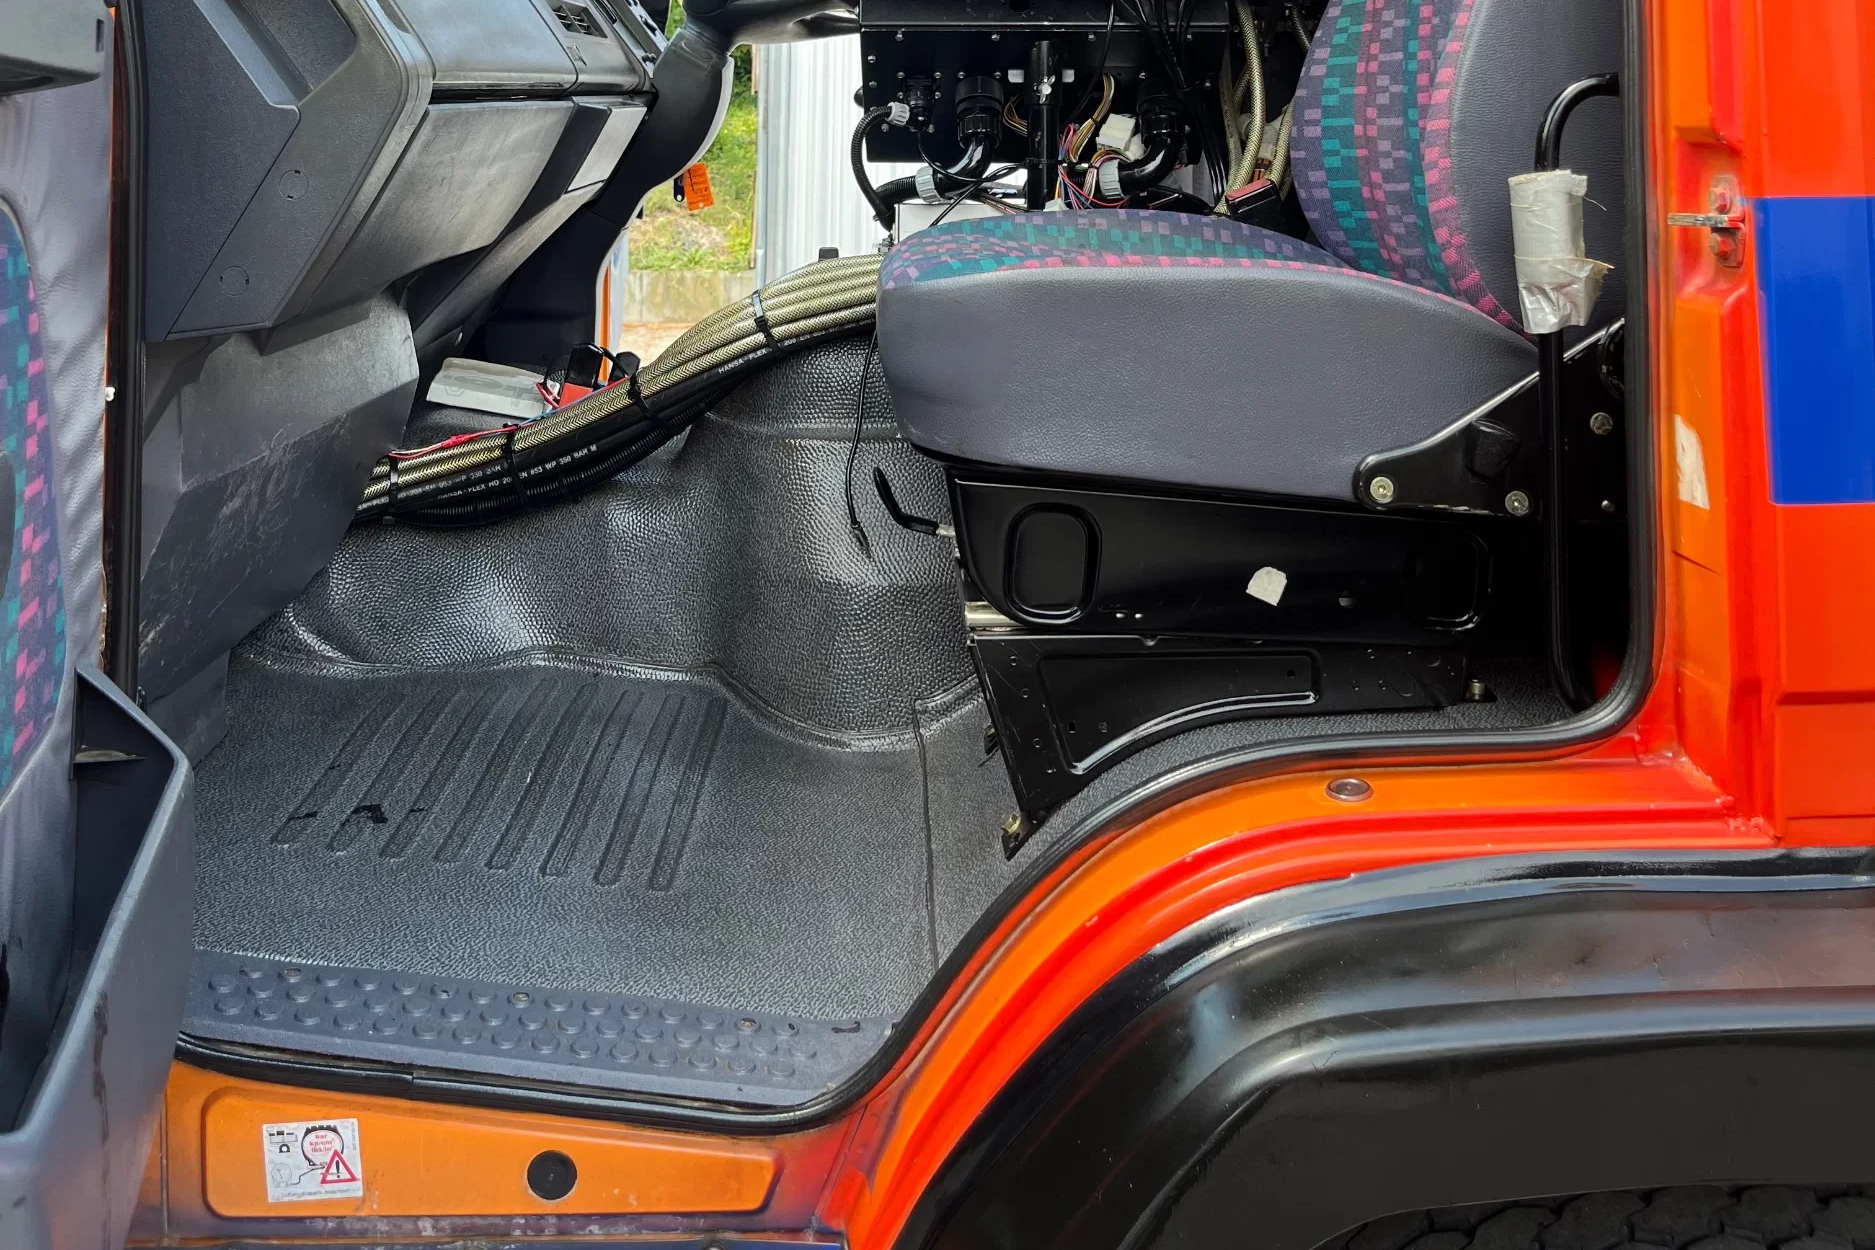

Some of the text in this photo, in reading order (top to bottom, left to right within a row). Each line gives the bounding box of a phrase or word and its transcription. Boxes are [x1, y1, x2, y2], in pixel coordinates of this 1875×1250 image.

[530, 466, 543, 476] 853
[545, 460, 557, 470] WP
[559, 455, 572, 466] 350
[573, 448, 589, 459] BAR
